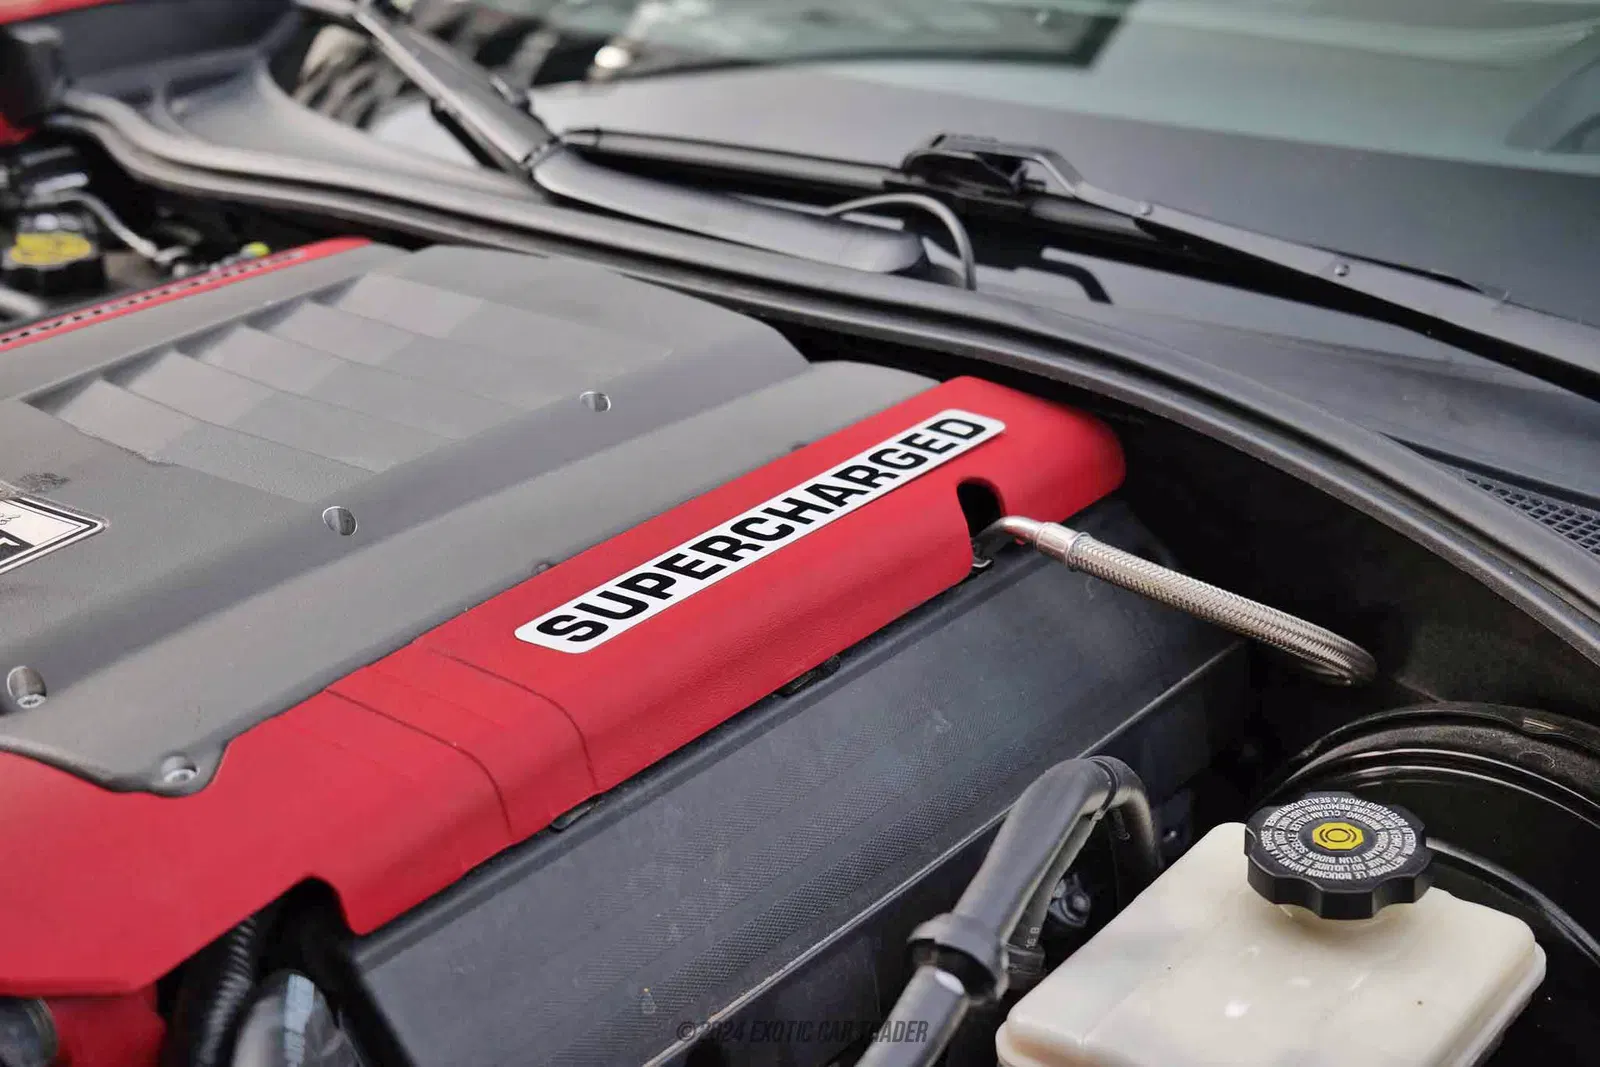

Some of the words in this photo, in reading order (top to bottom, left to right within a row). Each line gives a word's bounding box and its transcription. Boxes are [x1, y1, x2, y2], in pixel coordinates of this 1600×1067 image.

[536, 418, 986, 643] SUPERCHARGED
[1298, 797, 1331, 807] SEALED
[1341, 797, 1367, 807] FROM
[1301, 803, 1351, 813] REMOVING.
[1352, 805, 1385, 821] BEFORE
[1367, 802, 1392, 816] FLUID
[1286, 809, 1305, 820] USE
[1310, 810, 1341, 819] CLEAN
[1387, 812, 1409, 827] DOT3
[1289, 815, 1313, 832] FILLER
[1380, 819, 1396, 829] CAP
[1270, 849, 1285, 859] LA
[1279, 844, 1302, 861] FREIN
[1306, 851, 1336, 864] BIDON
[1278, 857, 1307, 873] AVANT
[1299, 857, 1313, 866] DE
[1339, 855, 1362, 864] D'UN
[1365, 857, 1386, 869] QUE
[1312, 862, 1350, 872] LIQUIDE
[1352, 863, 1366, 871] DU
[1367, 855, 1408, 877] NETTOYER
[1305, 868, 1352, 880] BOUCHON
[1353, 870, 1367, 879] LE
